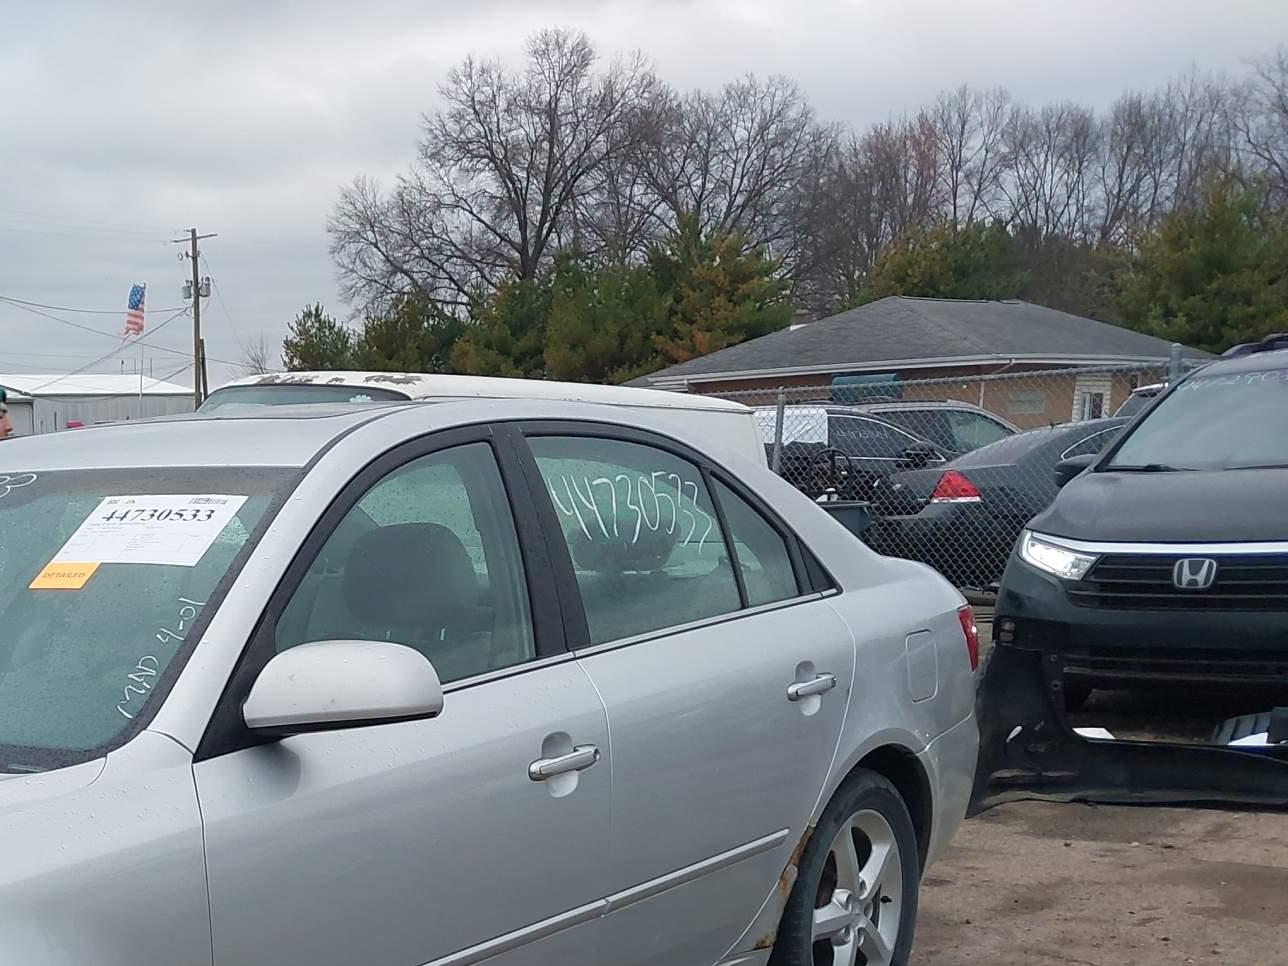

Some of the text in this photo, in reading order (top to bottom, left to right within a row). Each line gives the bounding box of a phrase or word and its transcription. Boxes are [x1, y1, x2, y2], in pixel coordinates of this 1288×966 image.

[101, 508, 216, 522] 44730533
[548, 471, 713, 555] 44730533
[155, 597, 207, 643] 4-01
